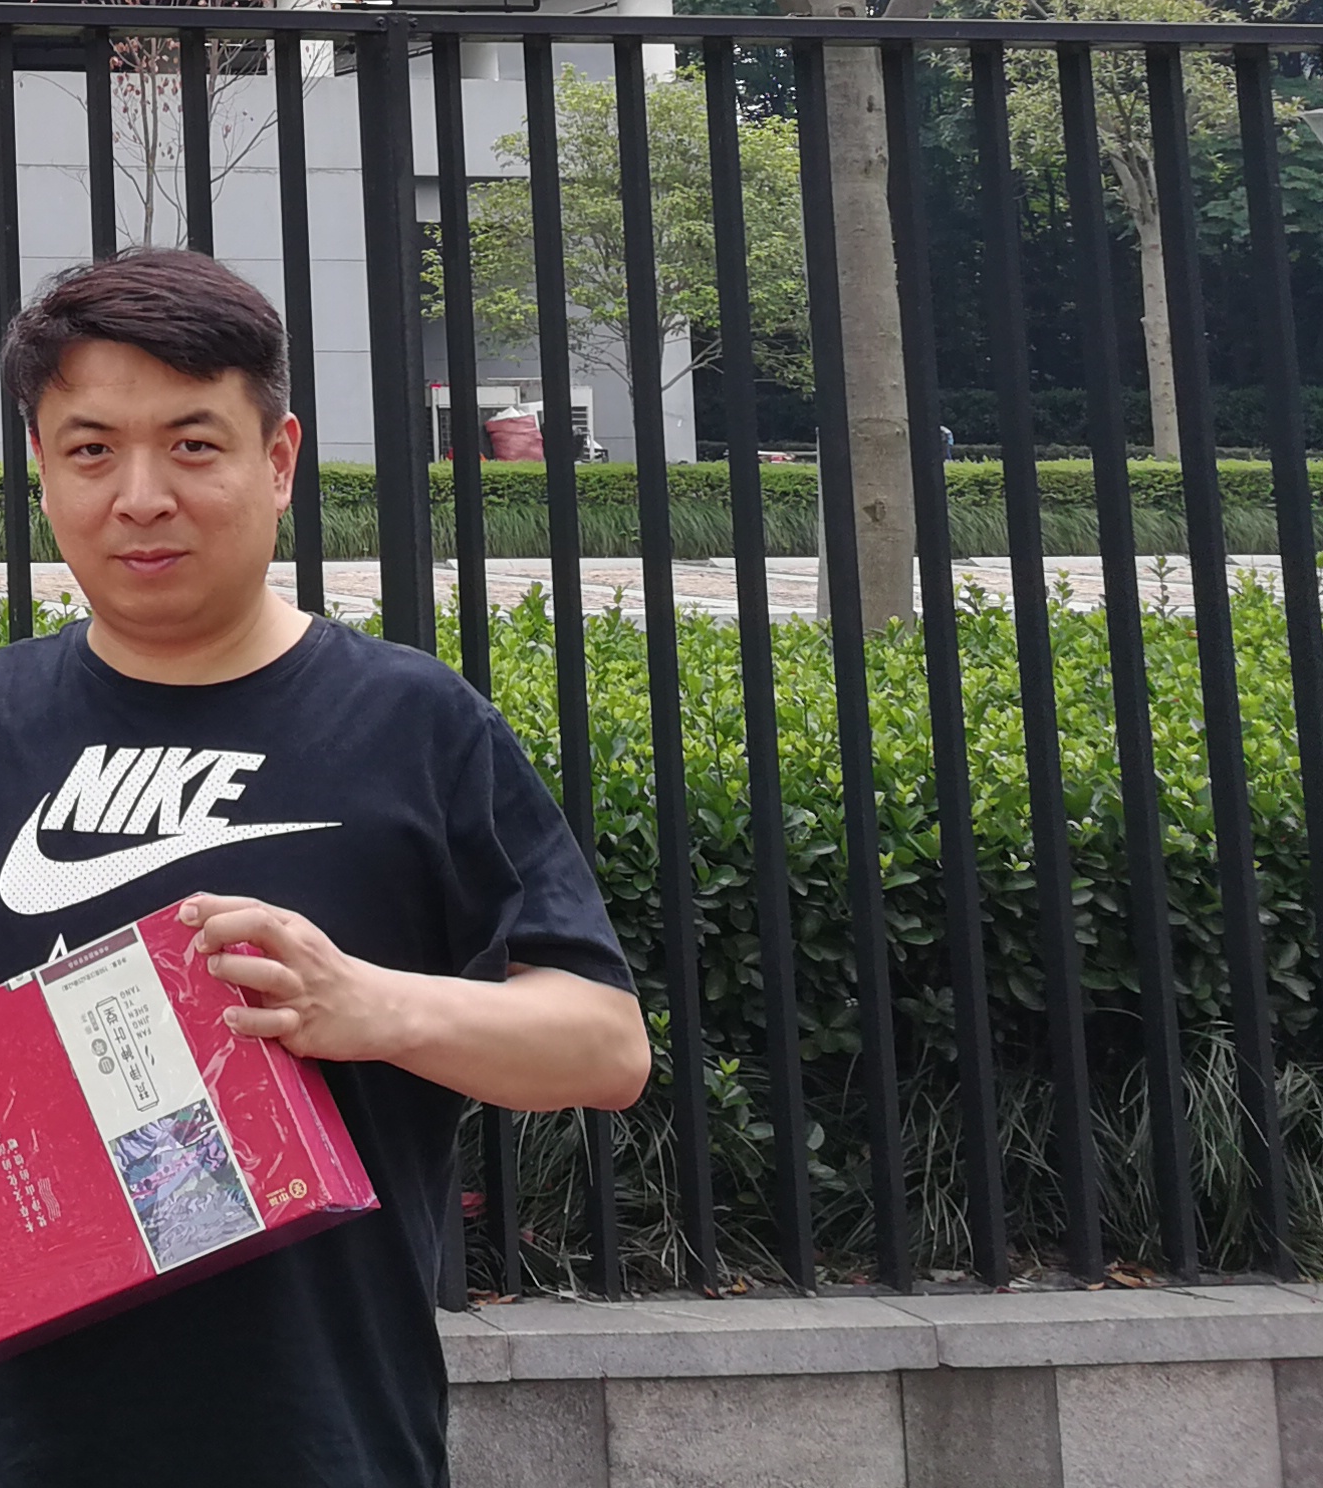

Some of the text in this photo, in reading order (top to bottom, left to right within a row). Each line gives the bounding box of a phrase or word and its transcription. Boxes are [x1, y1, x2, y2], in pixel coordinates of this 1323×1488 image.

[41, 745, 267, 836] NIKE
[125, 1000, 134, 1010] YE
[128, 1004, 149, 1019] SHEN
[136, 1027, 152, 1040] FAN
